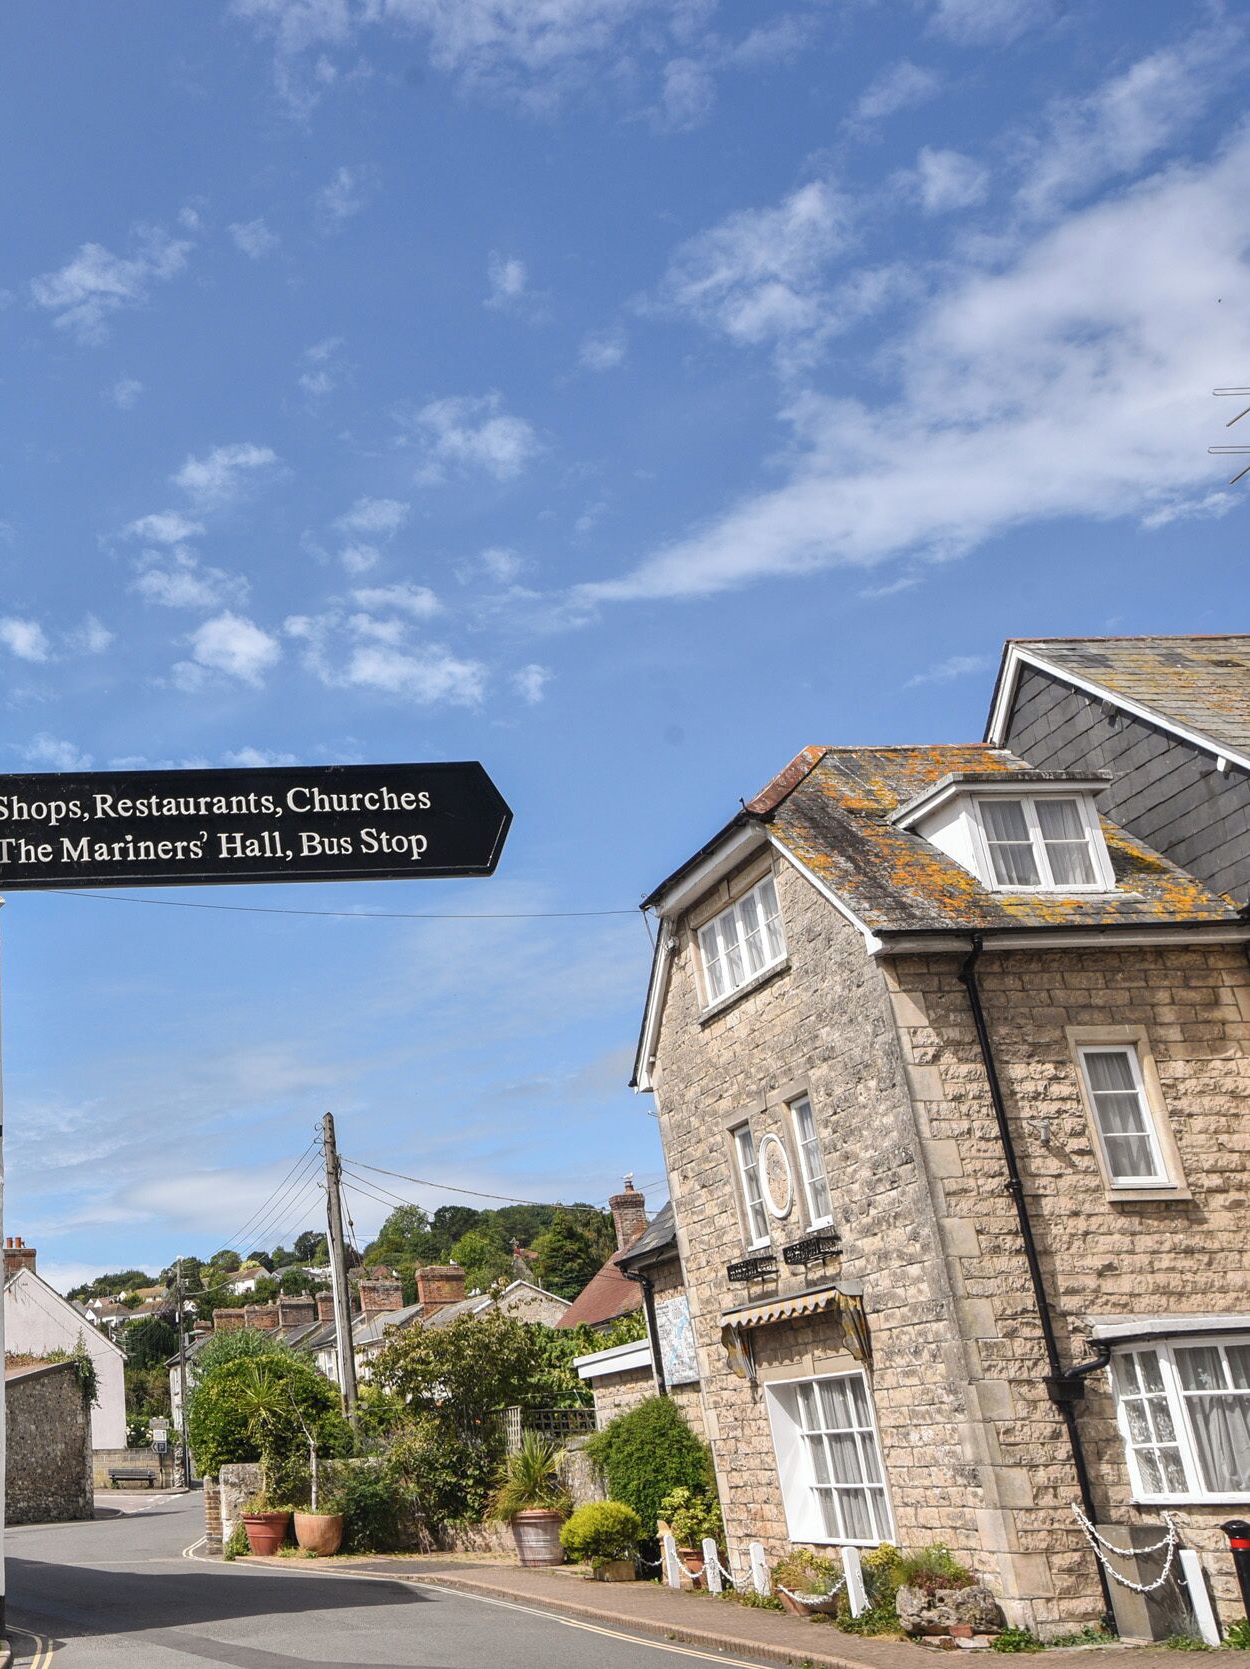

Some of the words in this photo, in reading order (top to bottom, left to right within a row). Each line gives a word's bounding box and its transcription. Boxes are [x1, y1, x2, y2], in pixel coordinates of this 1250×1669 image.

[92, 793, 283, 822] Restaurants,
[286, 786, 431, 813] Churches
[59, 830, 208, 863] Mariners'
[216, 831, 293, 862] Hall,
[298, 832, 353, 857] Bus
[360, 827, 428, 861] Stop
